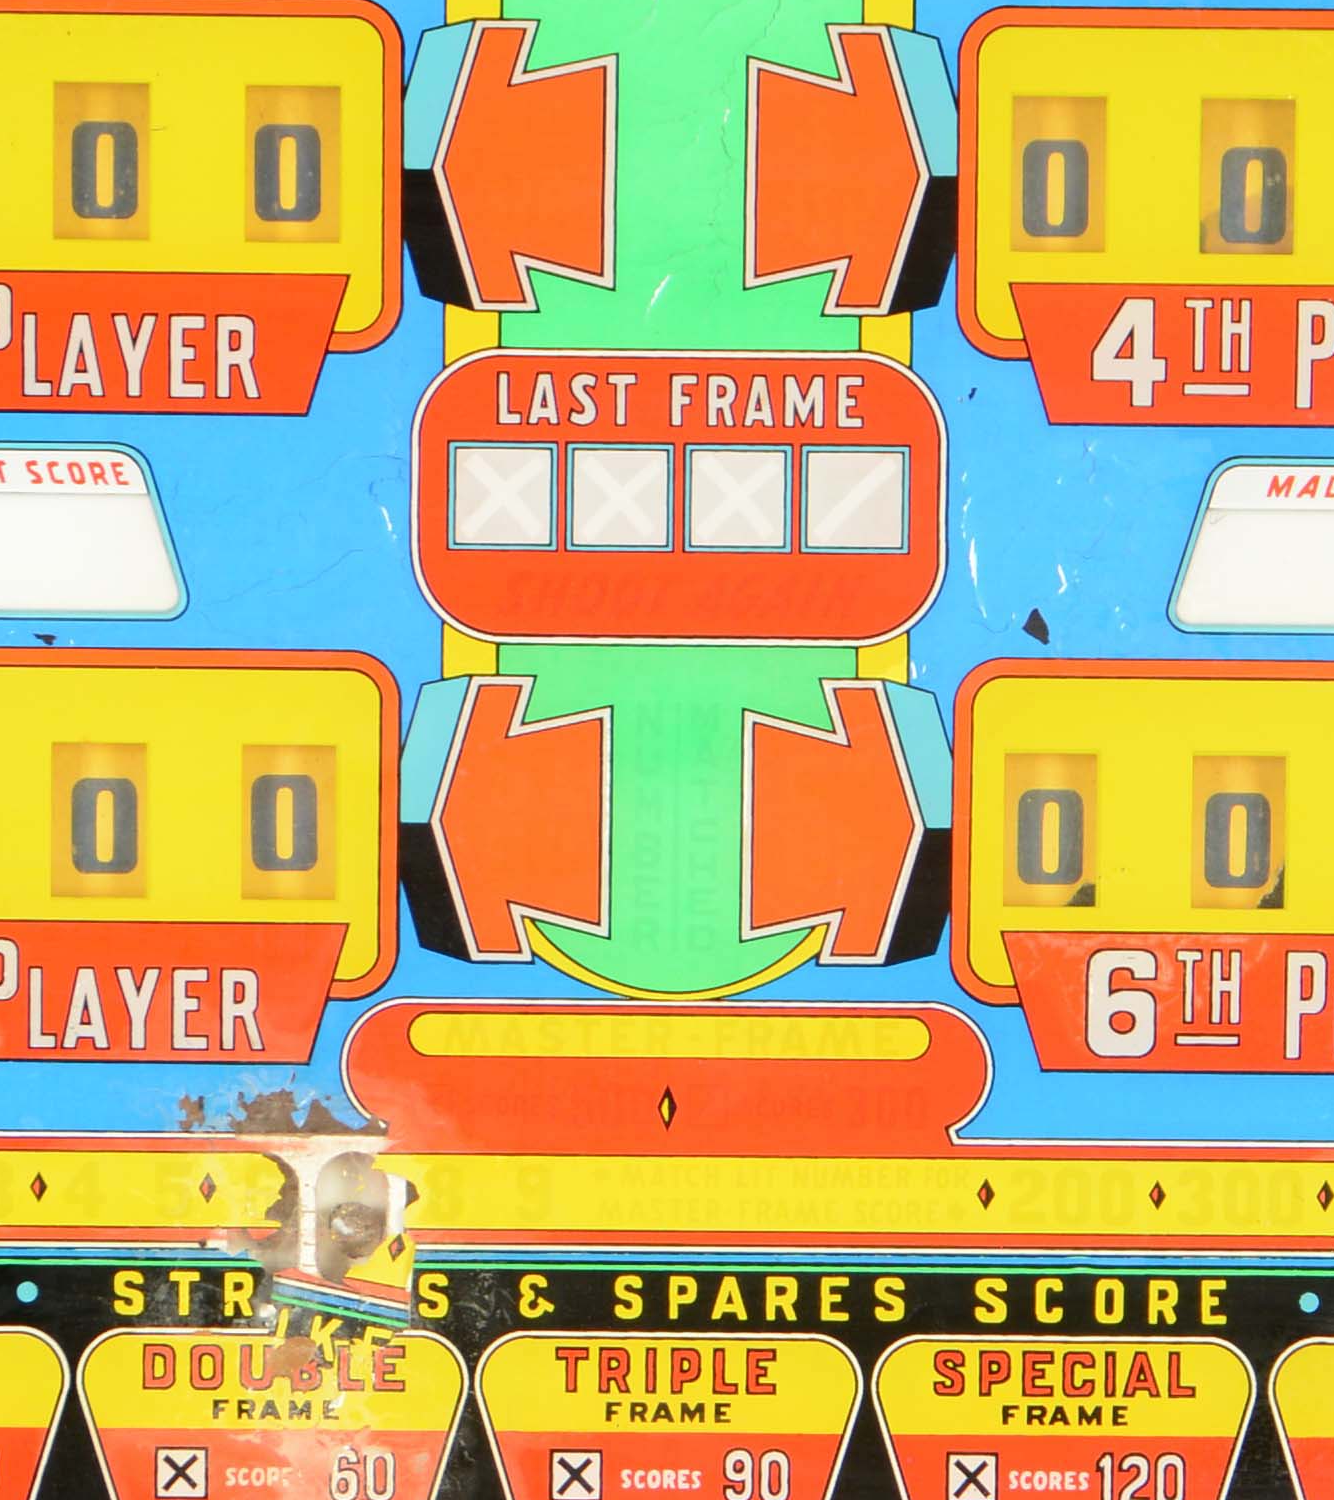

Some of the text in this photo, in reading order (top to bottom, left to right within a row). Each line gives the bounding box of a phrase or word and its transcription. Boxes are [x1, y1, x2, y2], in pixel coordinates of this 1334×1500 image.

[72, 121, 138, 220] 0
[254, 123, 322, 223] 0
[1021, 139, 1090, 238] 0
[1220, 146, 1288, 245] 0
[1090, 296, 1253, 408] 4TH
[495, 371, 865, 429] LAST FRAME
[25, 459, 130, 486] SCORE
[71, 777, 138, 874] 0
[250, 774, 319, 871] 0
[1017, 788, 1083, 887] 0
[1204, 792, 1271, 889] 0
[1085, 948, 1242, 1058] 6TH
[519, 1275, 555, 1318] &
[613, 1275, 906, 1324] SPARES
[974, 1279, 1228, 1325] SCORE
[555, 1347, 777, 1395] TRIPLE
[933, 1350, 1197, 1398] SPECIAL
[212, 1399, 340, 1421] FRAME
[605, 1402, 732, 1423] FRAME
[1001, 1404, 1128, 1426] FRAME
[225, 1467, 302, 1487] SCORE
[620, 1469, 702, 1490] SCORES
[1008, 1470, 1090, 1491] SCORES
